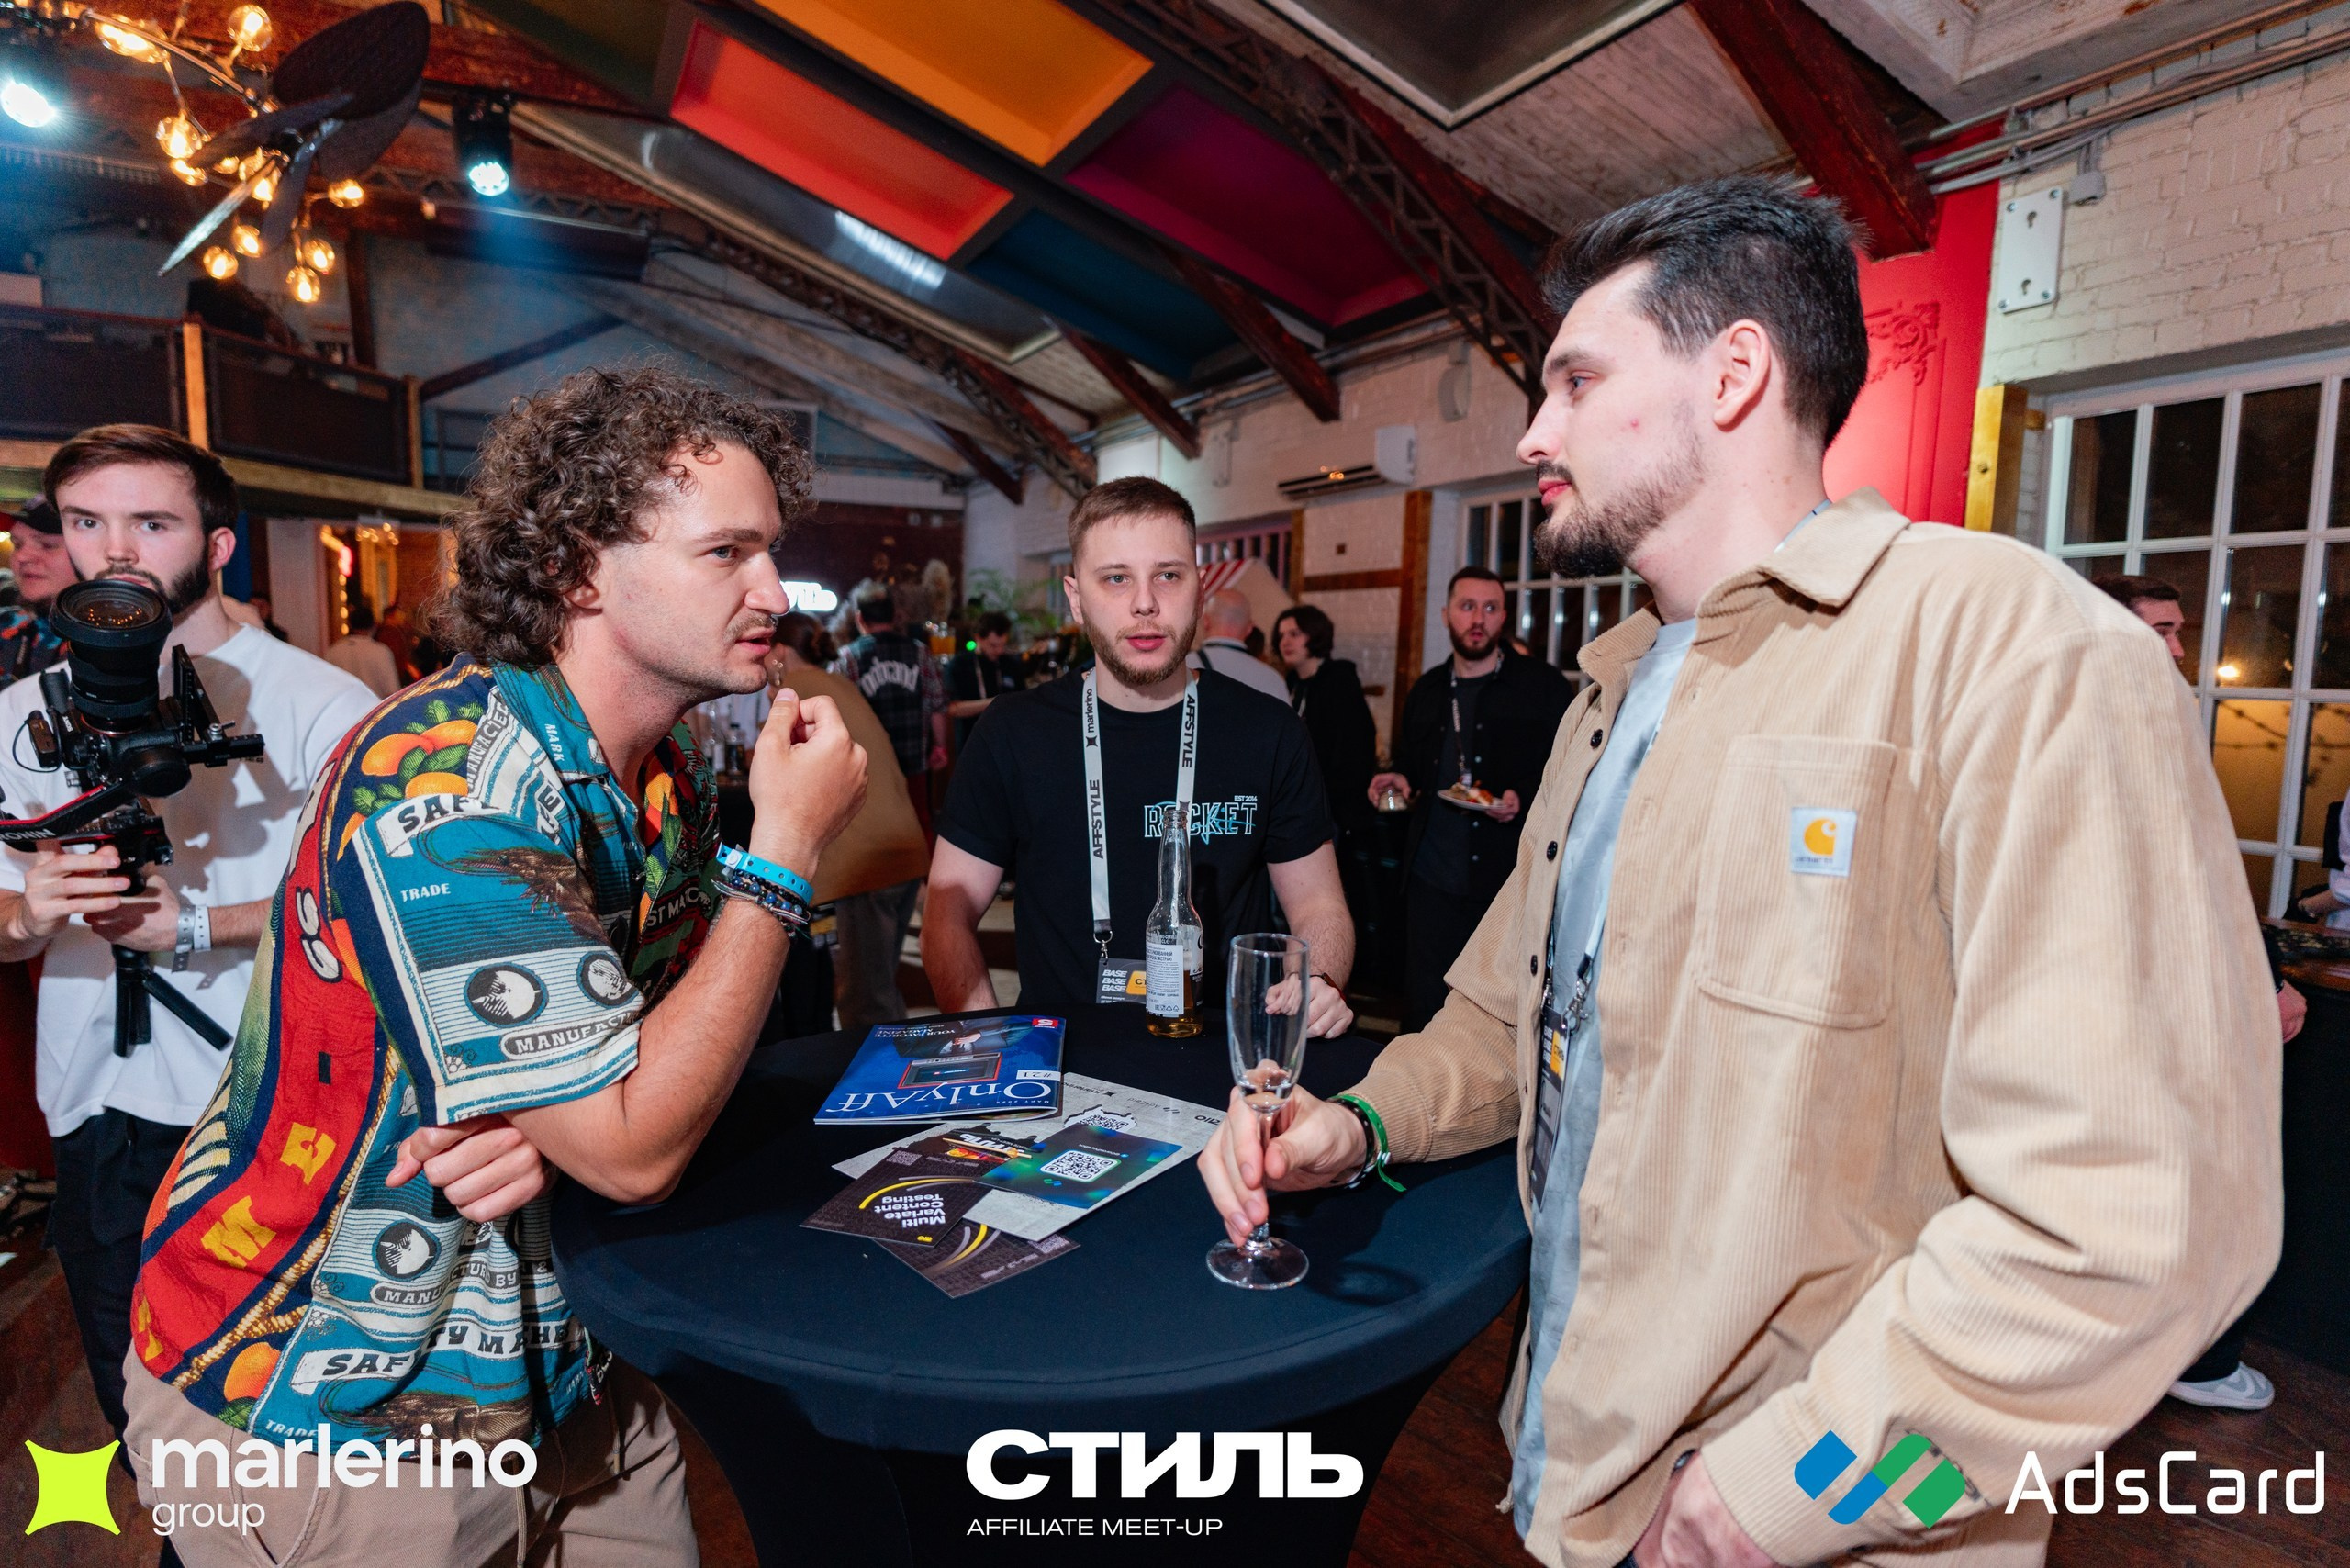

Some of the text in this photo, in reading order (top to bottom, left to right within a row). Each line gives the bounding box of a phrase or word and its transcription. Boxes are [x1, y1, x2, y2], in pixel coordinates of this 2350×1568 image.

[1086, 689, 1095, 733] marlerino
[544, 723, 565, 762] MARK
[1182, 694, 1196, 767] AFFSTYLE
[1090, 779, 1103, 859] AFFSTYLE
[400, 883, 451, 902] TRADE
[825, 1081, 1052, 1113] OnlyAff
[875, 1201, 945, 1214] Content
[882, 1193, 944, 1204] Testing
[884, 1208, 946, 1220] Variate
[901, 1215, 946, 1228] Multi
